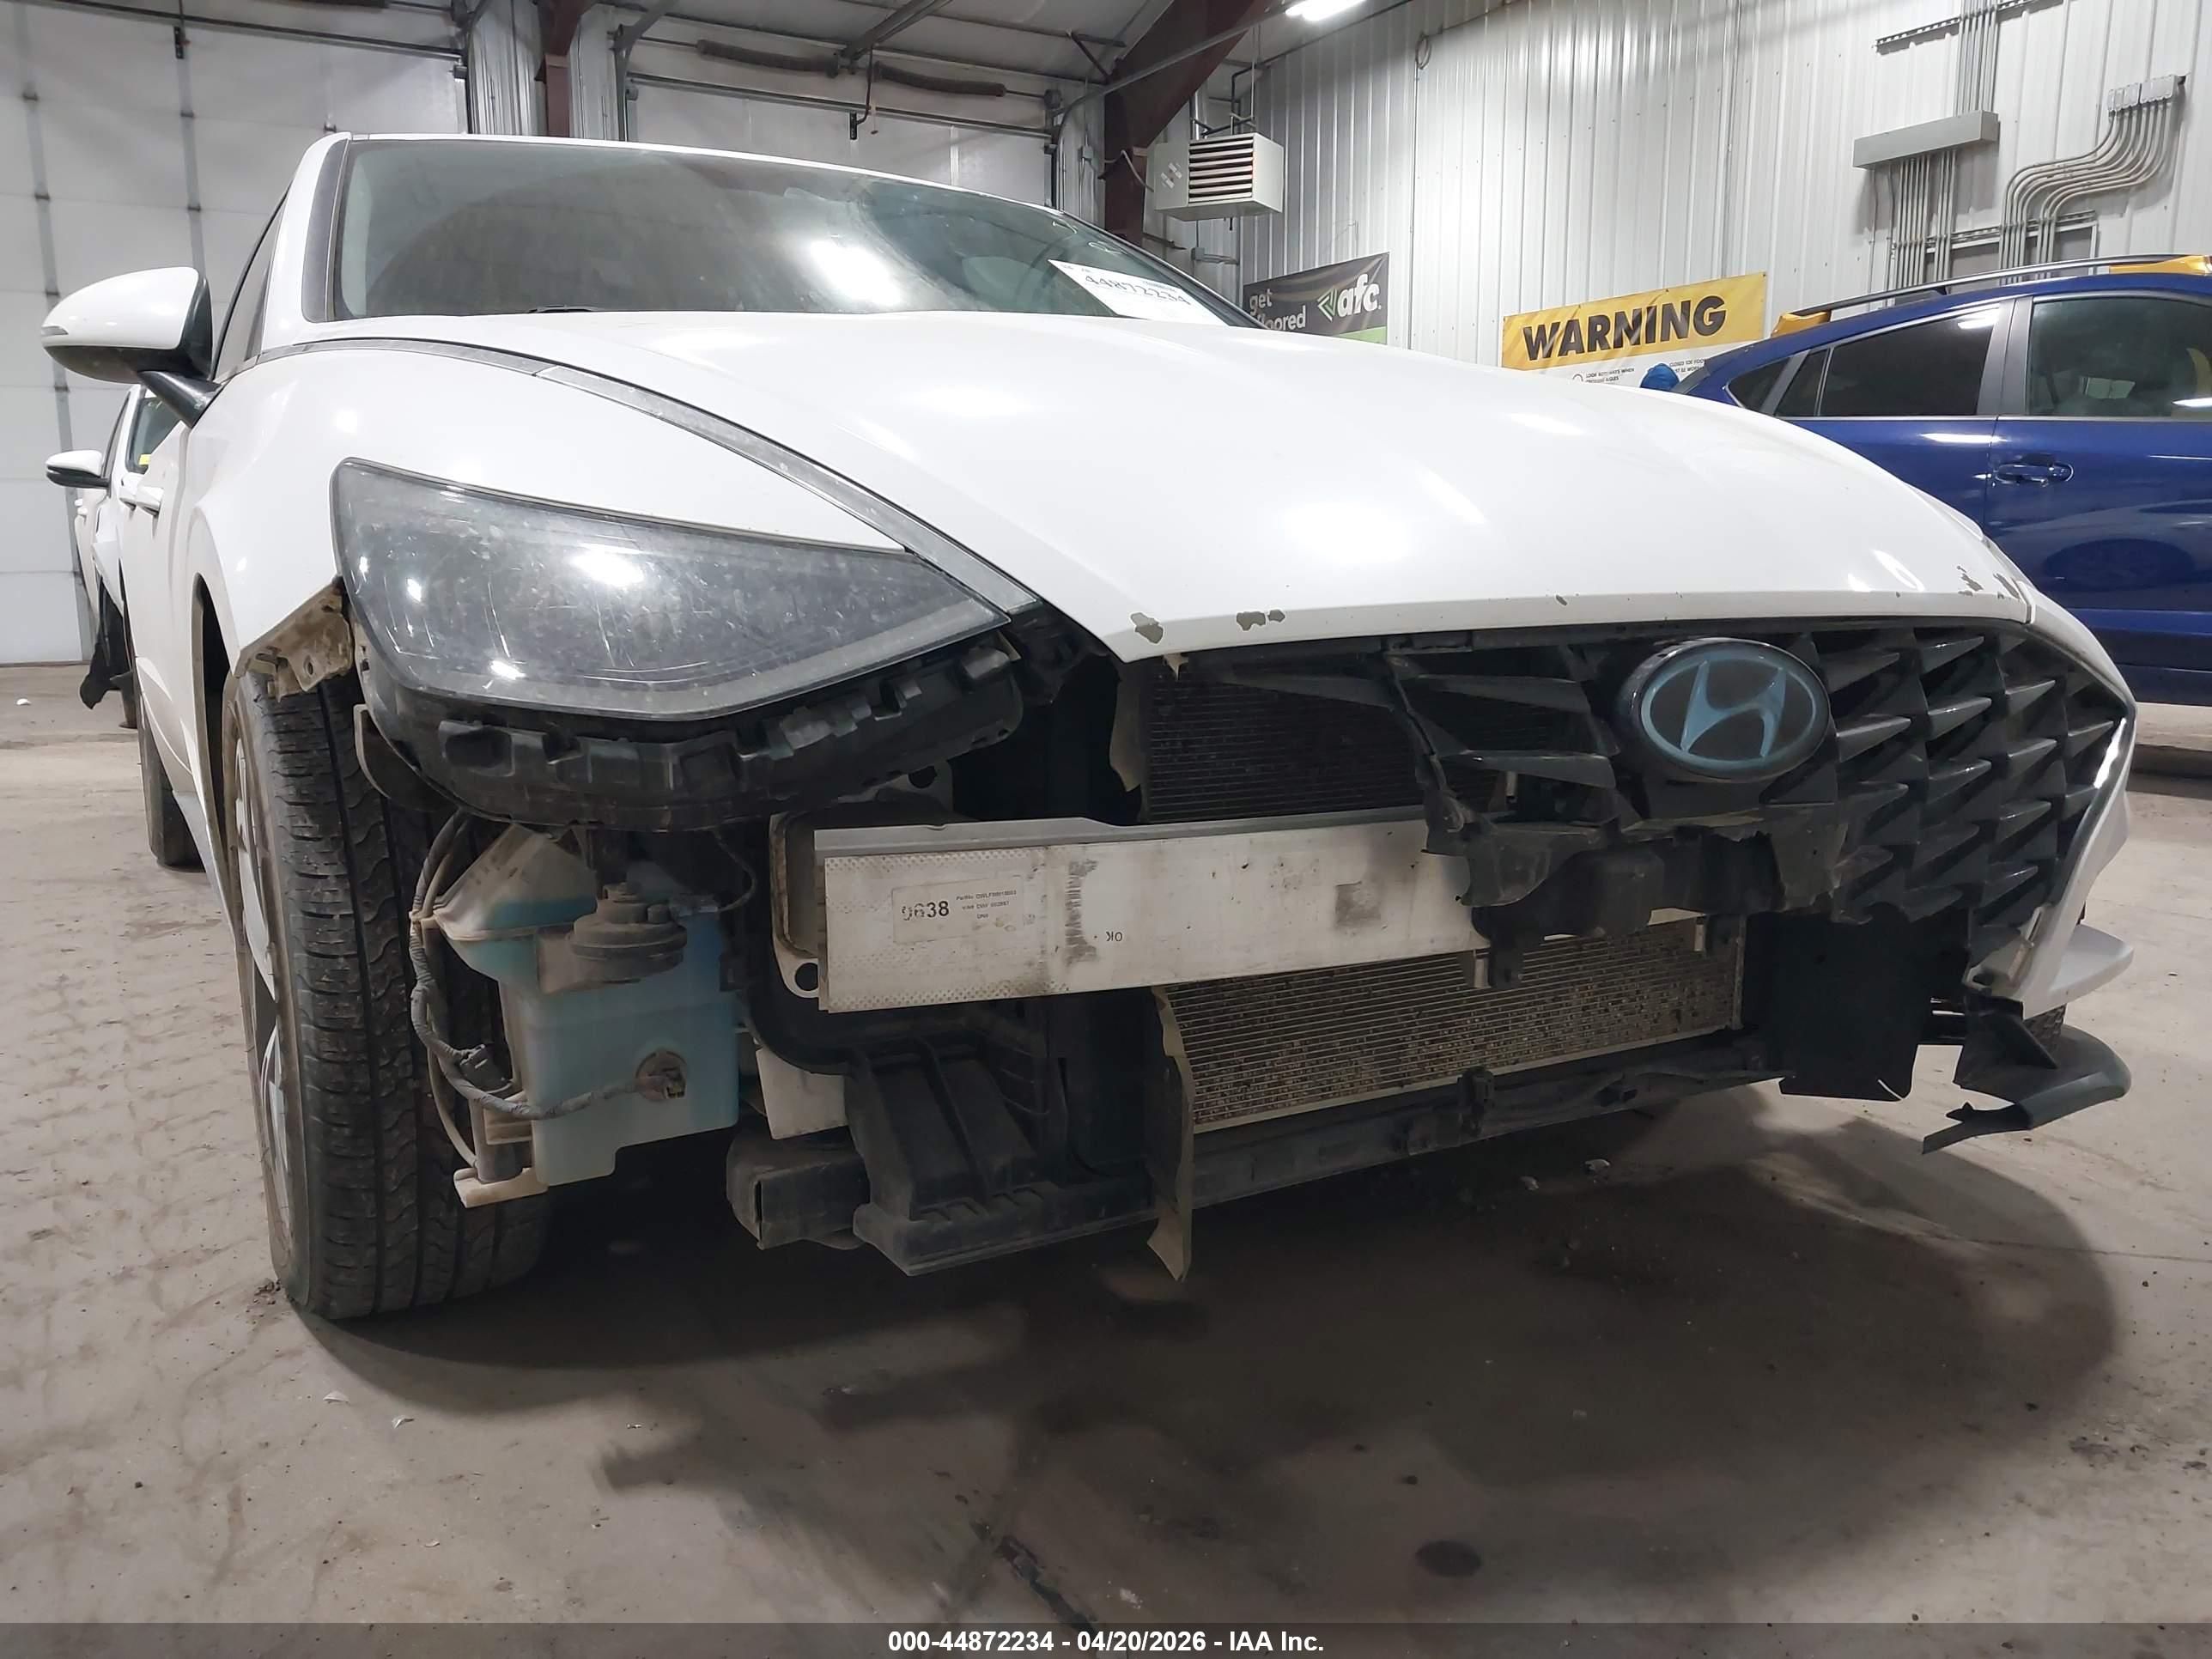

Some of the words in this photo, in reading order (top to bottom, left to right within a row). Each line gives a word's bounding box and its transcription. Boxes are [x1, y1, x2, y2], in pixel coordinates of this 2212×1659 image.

[1085, 275, 1191, 305] 44872234
[1249, 289, 1273, 315] get
[1337, 274, 1380, 317] afc
[1522, 295, 1727, 362] WARNING
[1105, 931, 1123, 942] OK
